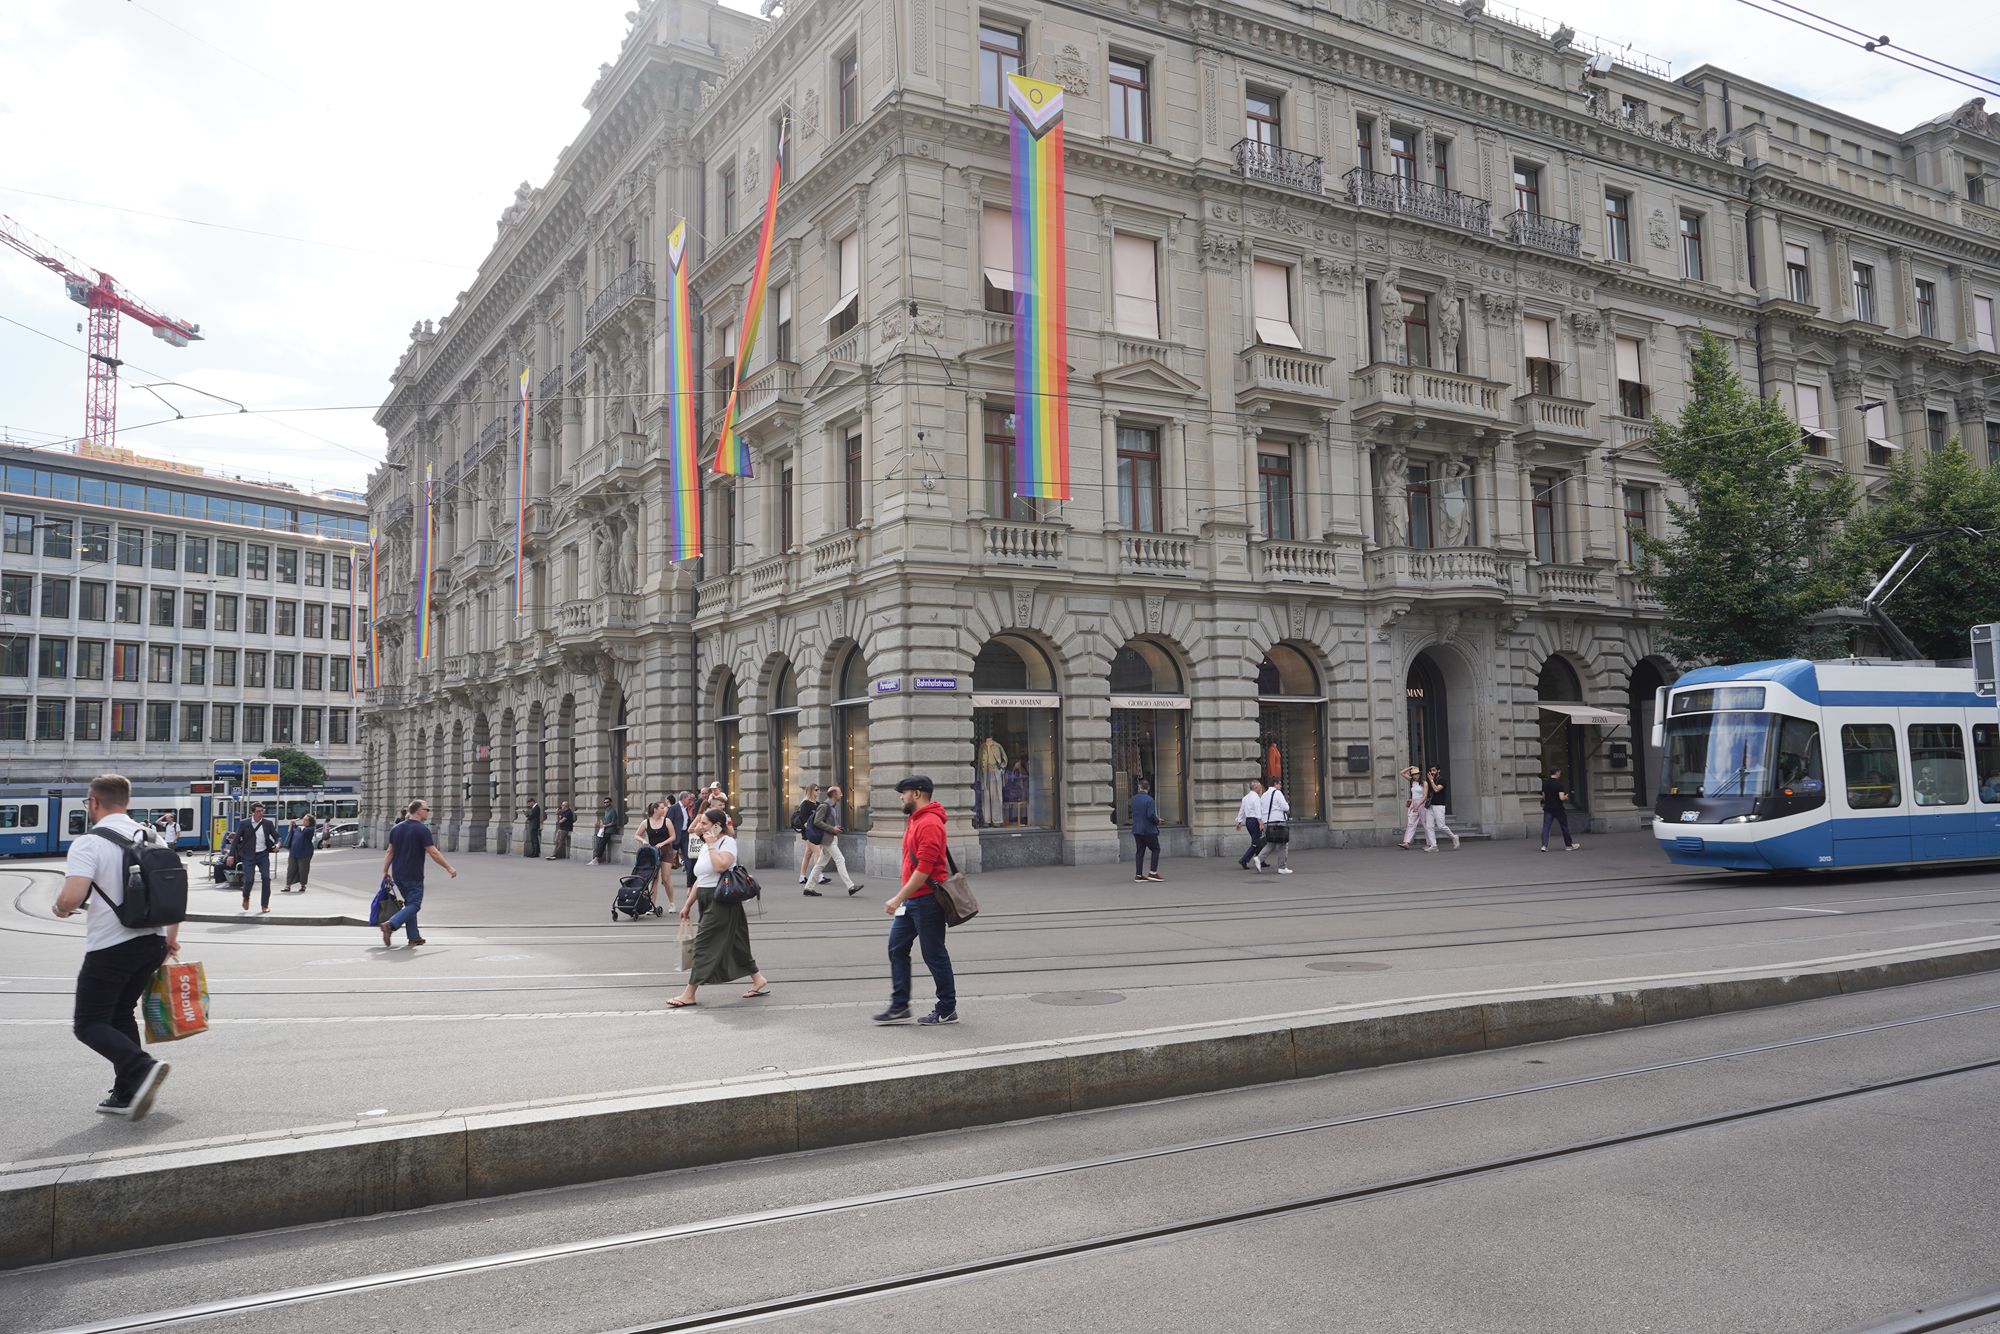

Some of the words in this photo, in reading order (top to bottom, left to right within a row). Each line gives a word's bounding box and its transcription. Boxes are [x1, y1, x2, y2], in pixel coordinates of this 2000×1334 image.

[916, 679, 955, 687] Bahnhofstrasse
[1407, 689, 1424, 697] MANI
[1681, 696, 1690, 709] 7
[179, 974, 196, 1022] MIGROS
